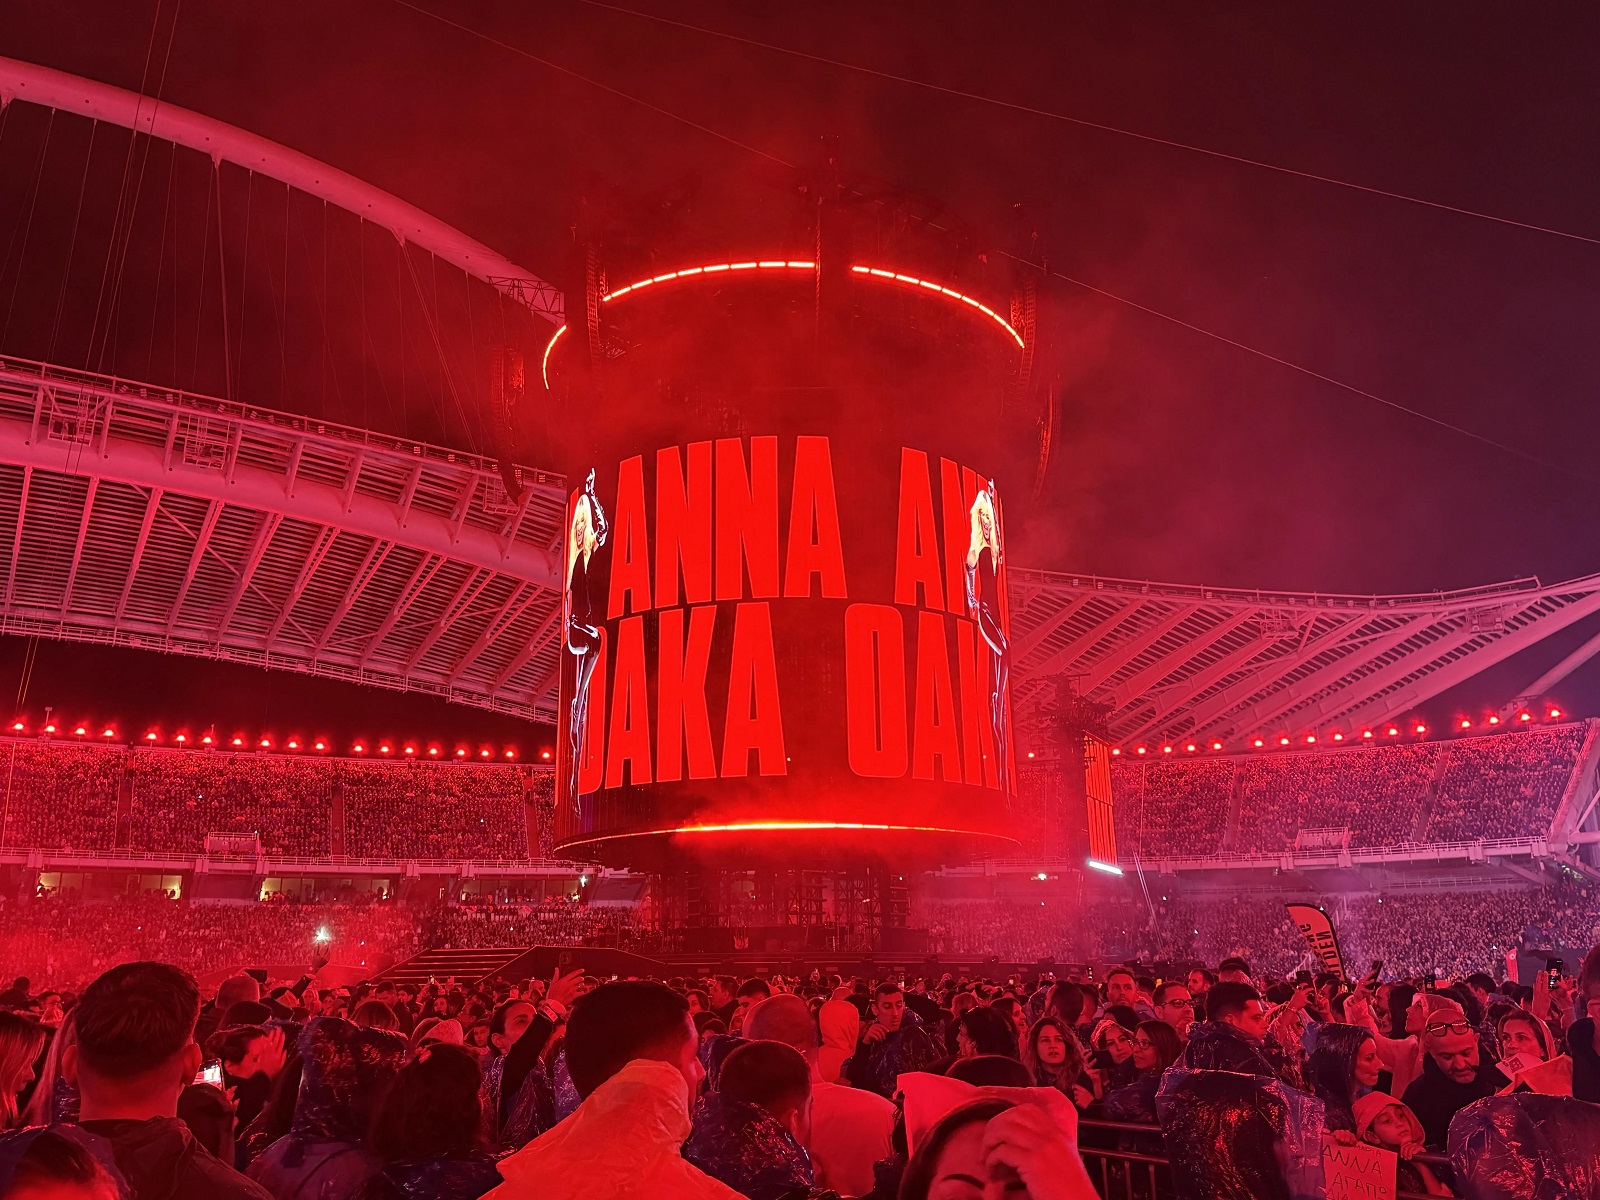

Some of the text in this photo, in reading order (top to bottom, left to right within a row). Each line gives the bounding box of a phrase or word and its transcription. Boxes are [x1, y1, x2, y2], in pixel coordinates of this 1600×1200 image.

[607, 436, 848, 620] ANNA
[895, 447, 1010, 643] AN
[845, 603, 1018, 797] OAK
[1322, 1144, 1382, 1180] ΑΝΝΑ
